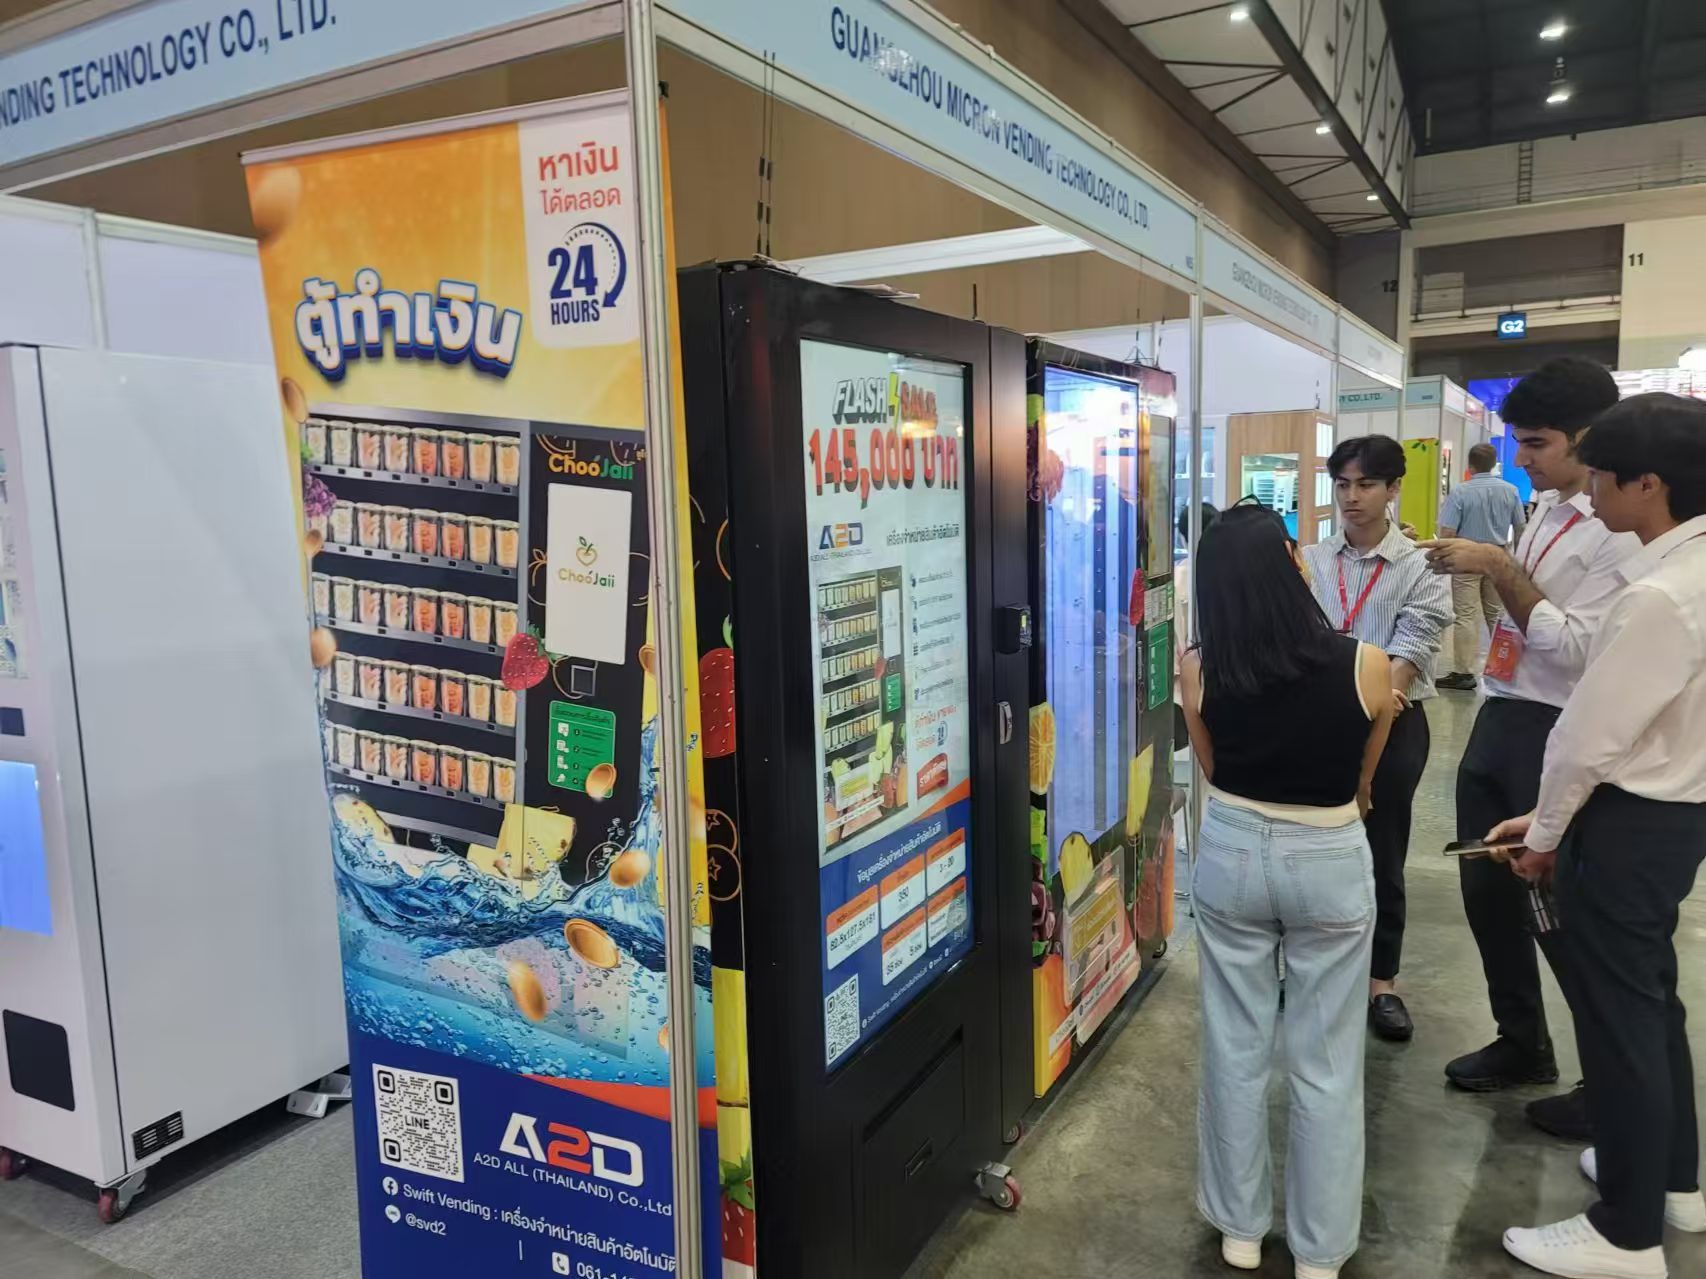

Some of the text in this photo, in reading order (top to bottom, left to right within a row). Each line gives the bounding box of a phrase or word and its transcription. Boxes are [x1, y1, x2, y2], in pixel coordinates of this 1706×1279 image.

[58, 21, 211, 107] TECHNOLOGY
[219, 9, 269, 55] CO.,
[277, 0, 336, 40] LTD.
[538, 141, 619, 181] หาเงิน
[1004, 120, 1053, 175] VENDING
[1055, 153, 1116, 210] TECHNOLOGY
[540, 187, 621, 215] ได้ตลอด
[548, 244, 598, 299] 24
[1628, 252, 1643, 266] 11
[295, 268, 522, 380] ตู้ทำเงิน
[551, 299, 600, 325] HOURS
[1501, 320, 1524, 333] G2
[833, 376, 887, 424] FLASH
[809, 428, 915, 510] 145,000
[819, 522, 863, 549] A2D
[405, 1115, 429, 1130] LINE
[500, 1112, 644, 1188] A2D
[474, 1152, 500, 1168] A2D
[504, 1159, 529, 1177] ALL
[533, 1168, 613, 1202] (THAILAND)
[403, 1184, 435, 1204] Swift
[437, 1192, 491, 1220] Vending
[405, 1212, 447, 1236] @svd2
